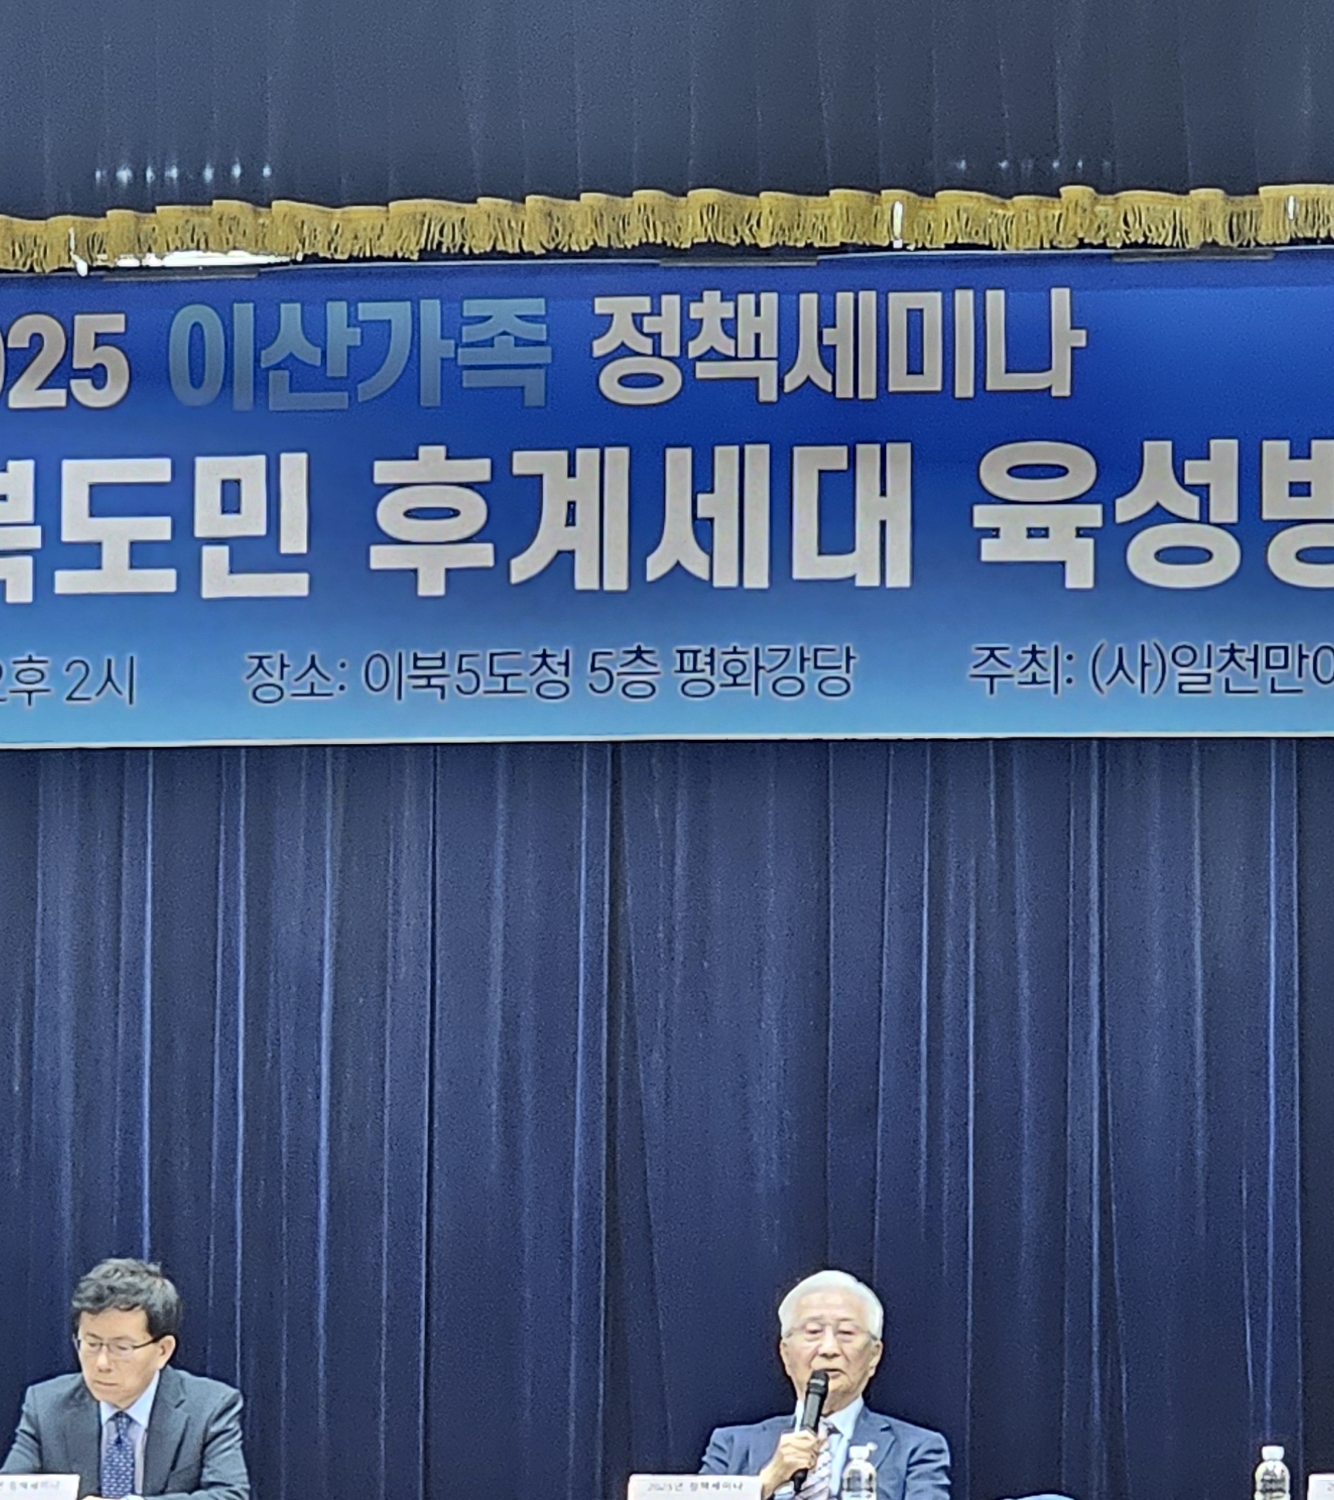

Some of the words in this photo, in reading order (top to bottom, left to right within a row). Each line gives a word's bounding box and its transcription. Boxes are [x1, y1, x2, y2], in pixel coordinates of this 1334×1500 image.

[168, 298, 553, 411] 이산가족
[591, 287, 1087, 404] 정책세미나
[369, 443, 913, 596] 후계세대
[64, 655, 137, 706] 2시
[244, 650, 347, 704] 장소:
[363, 647, 571, 701] 이북5도청
[586, 644, 660, 700] 5층
[673, 643, 857, 699] 평화강당
[967, 641, 1074, 696] 주최:
